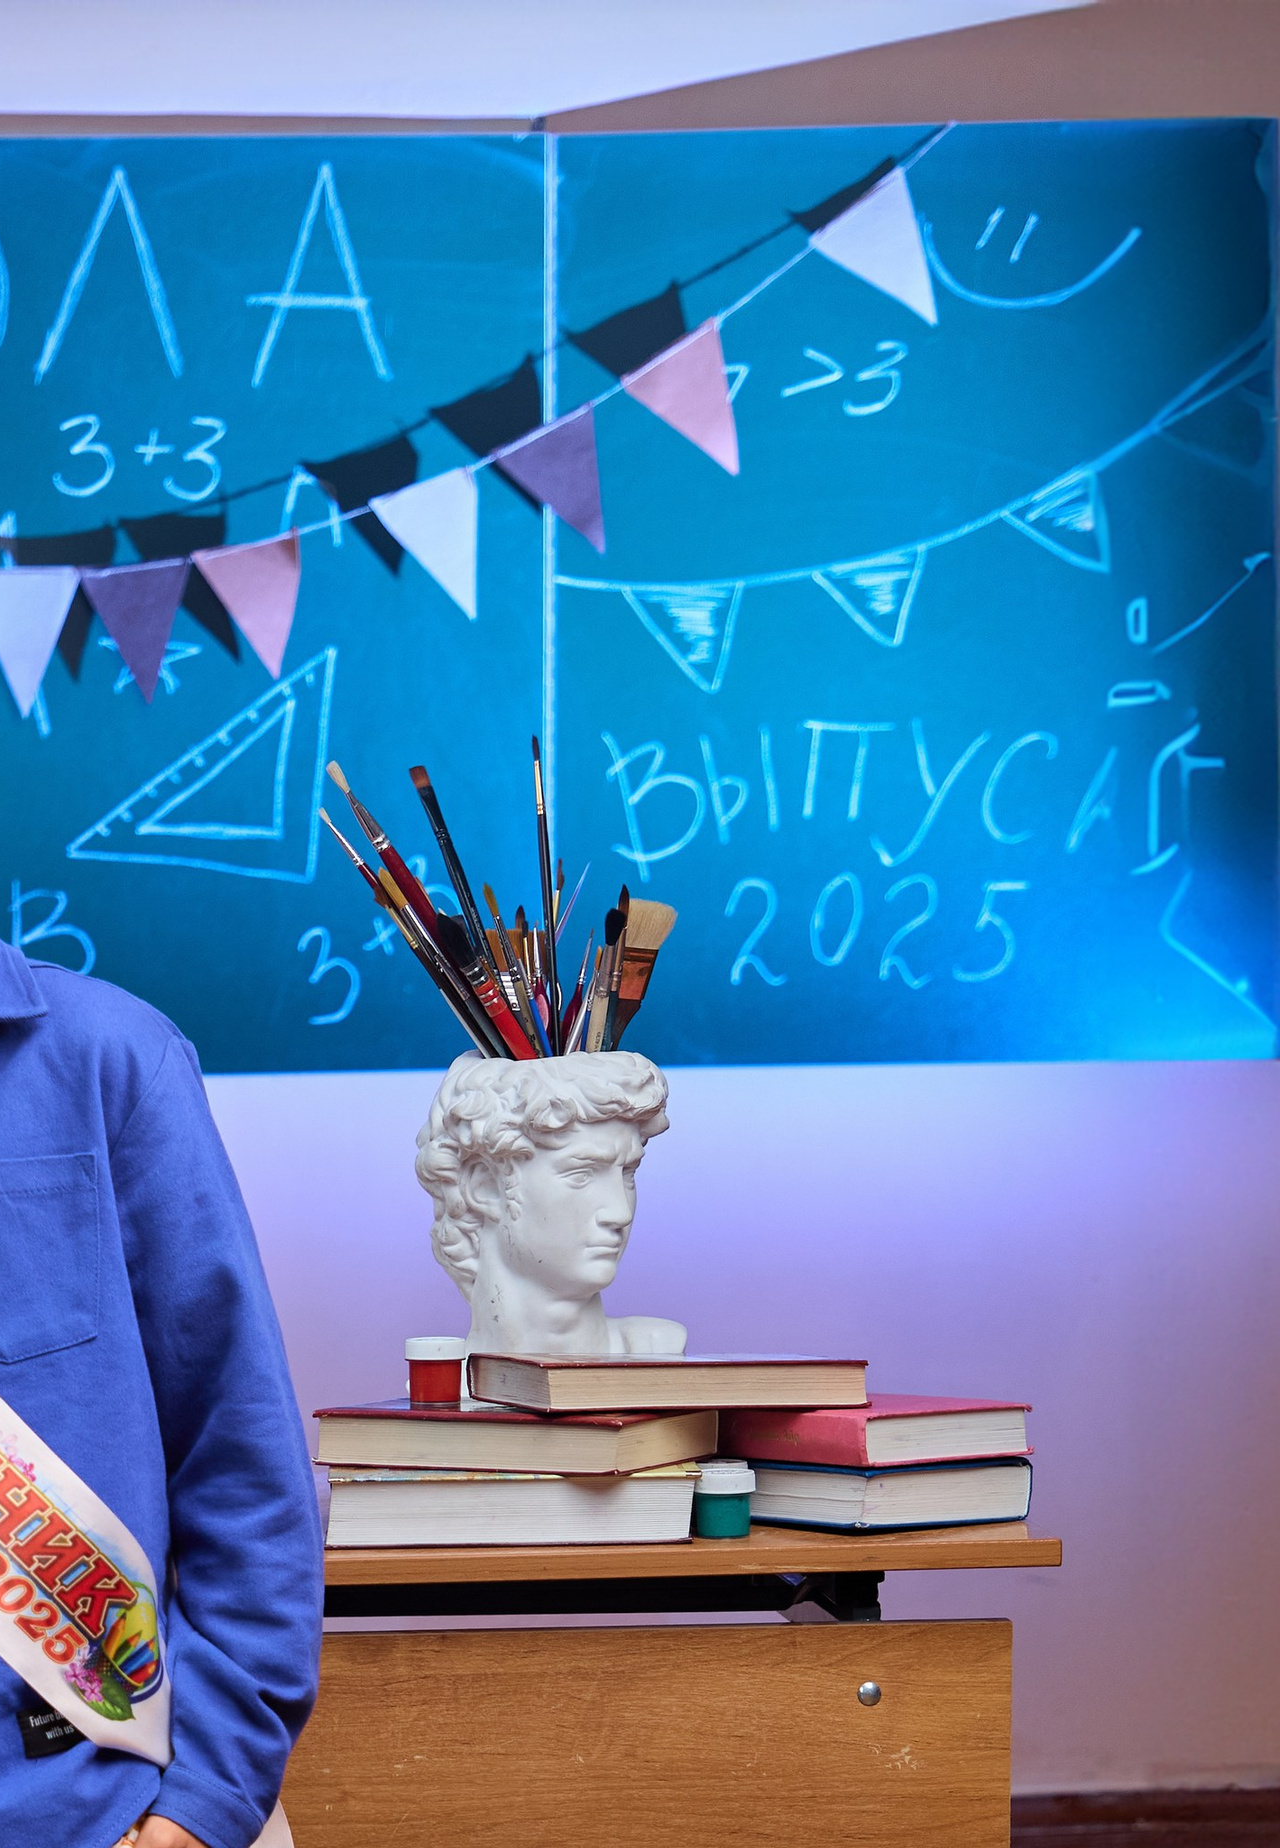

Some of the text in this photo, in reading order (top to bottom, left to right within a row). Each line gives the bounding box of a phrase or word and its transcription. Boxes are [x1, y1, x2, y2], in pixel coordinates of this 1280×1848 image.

[724, 871, 1031, 990] 2025
[29, 1713, 54, 1727] Future
[45, 1725, 74, 1739] with us
